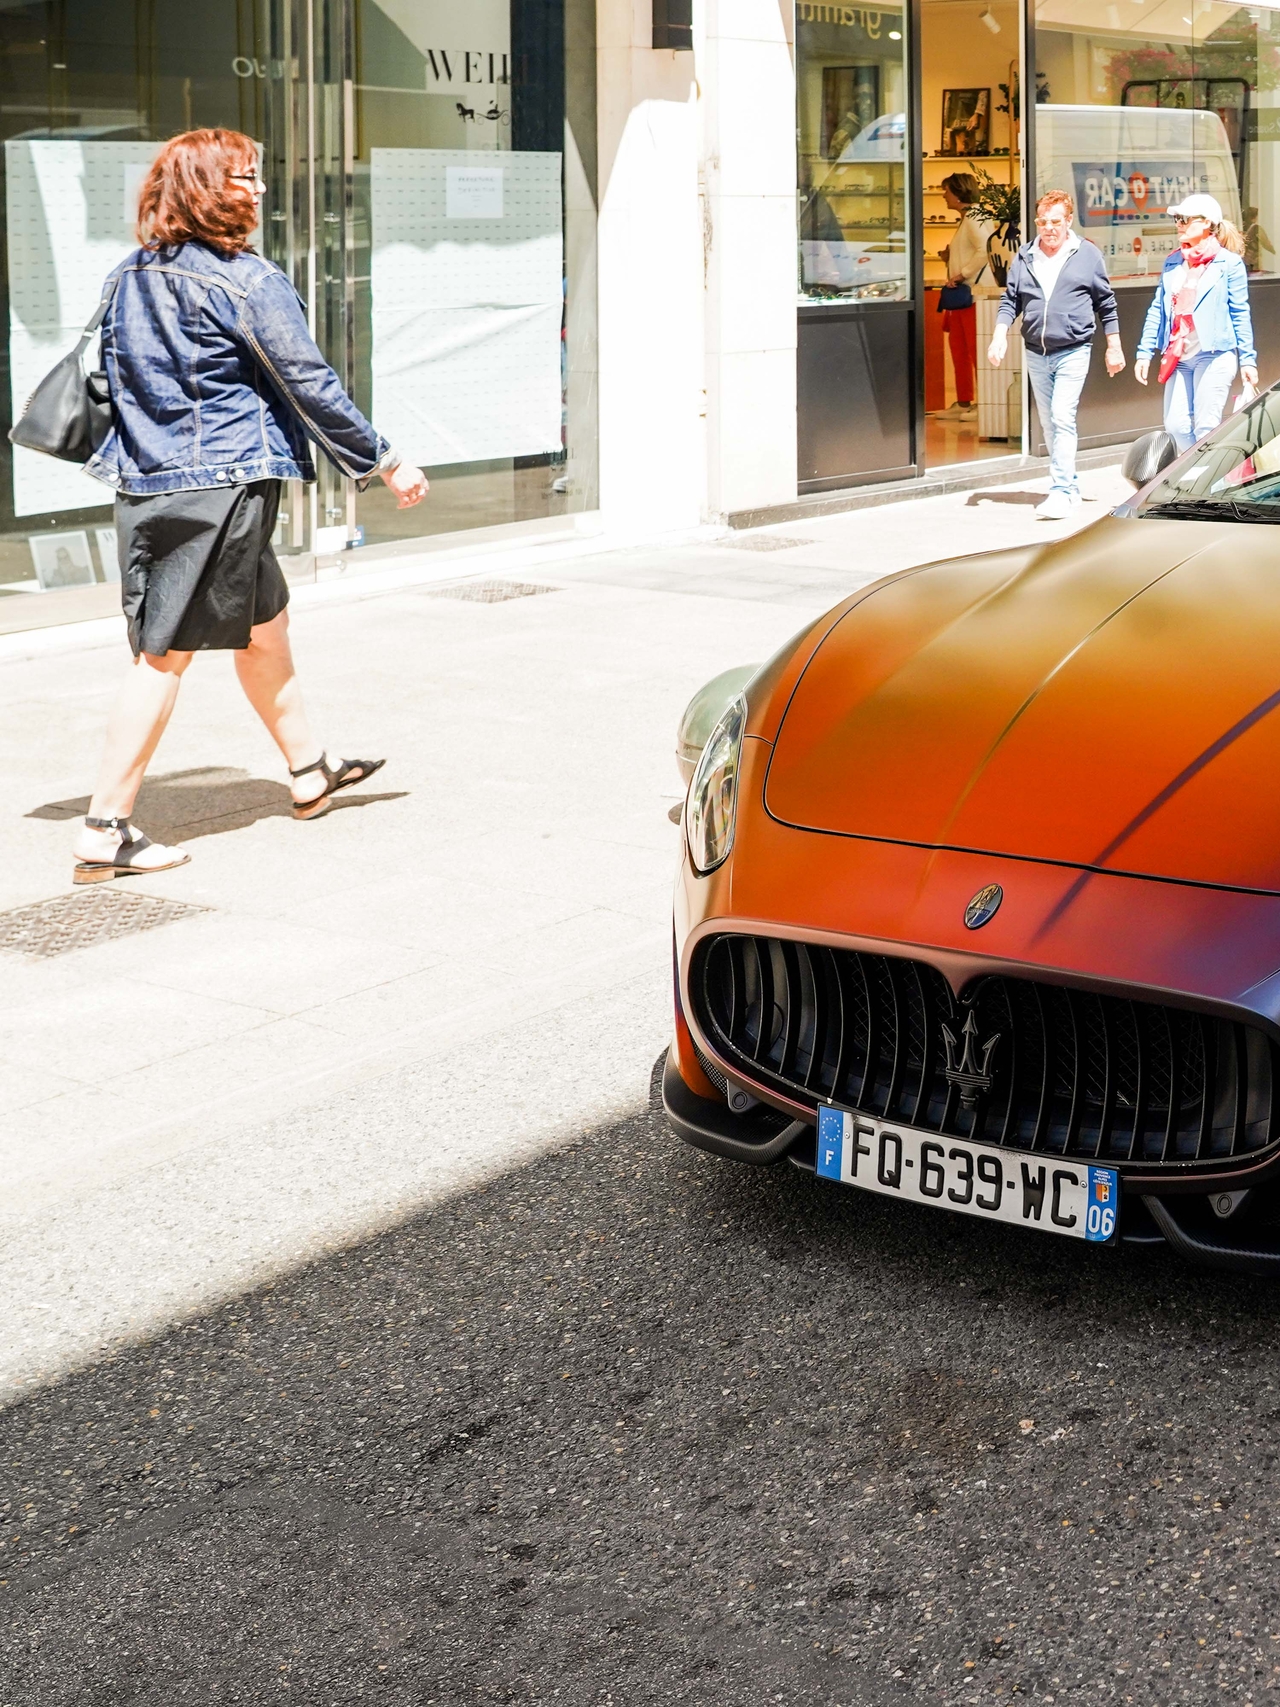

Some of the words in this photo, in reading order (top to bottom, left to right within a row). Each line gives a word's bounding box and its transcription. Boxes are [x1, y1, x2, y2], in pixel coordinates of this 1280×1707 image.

[825, 1150, 835, 1166] F
[851, 1123, 1079, 1228] FQ-639-WC
[1087, 1204, 1114, 1236] 06
